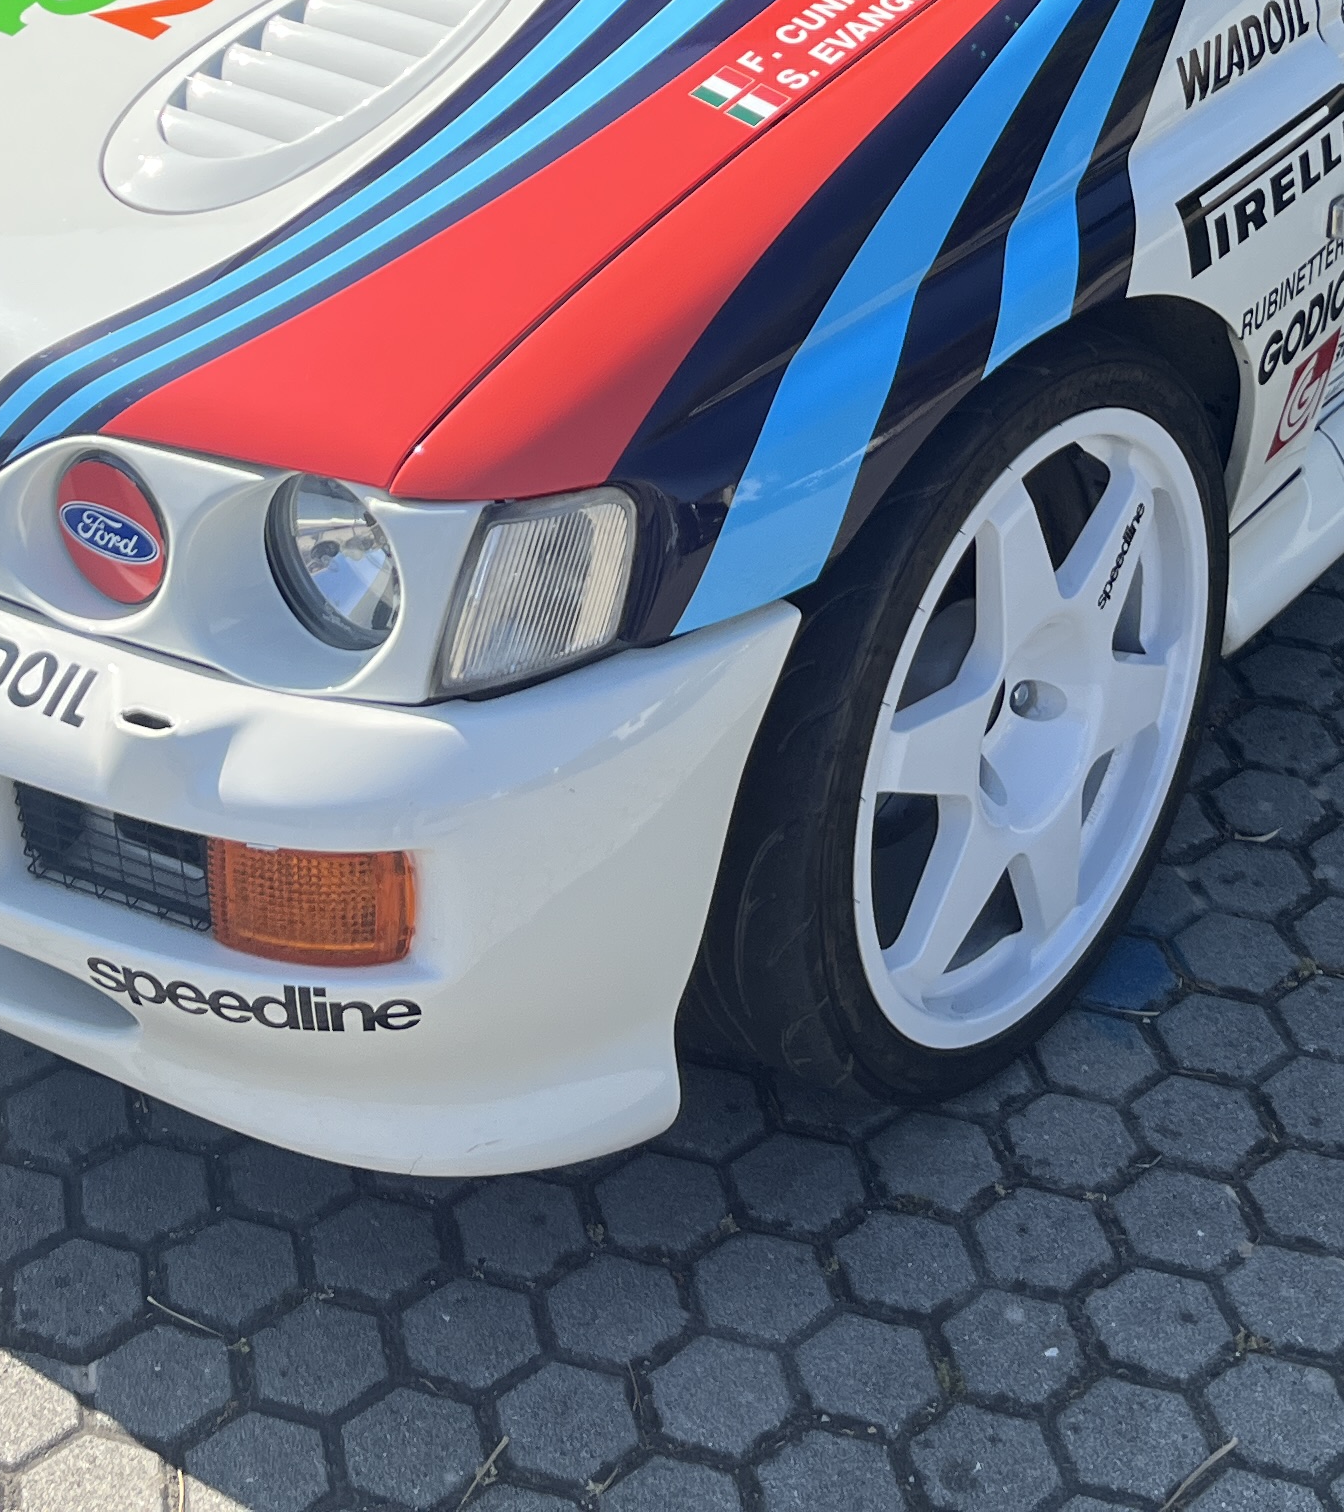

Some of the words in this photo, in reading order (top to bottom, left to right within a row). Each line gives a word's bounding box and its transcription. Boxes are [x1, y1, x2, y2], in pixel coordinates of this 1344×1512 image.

[75, 508, 139, 557] Ford
[1098, 502, 1145, 610] speedline
[87, 955, 423, 1033] speedline
